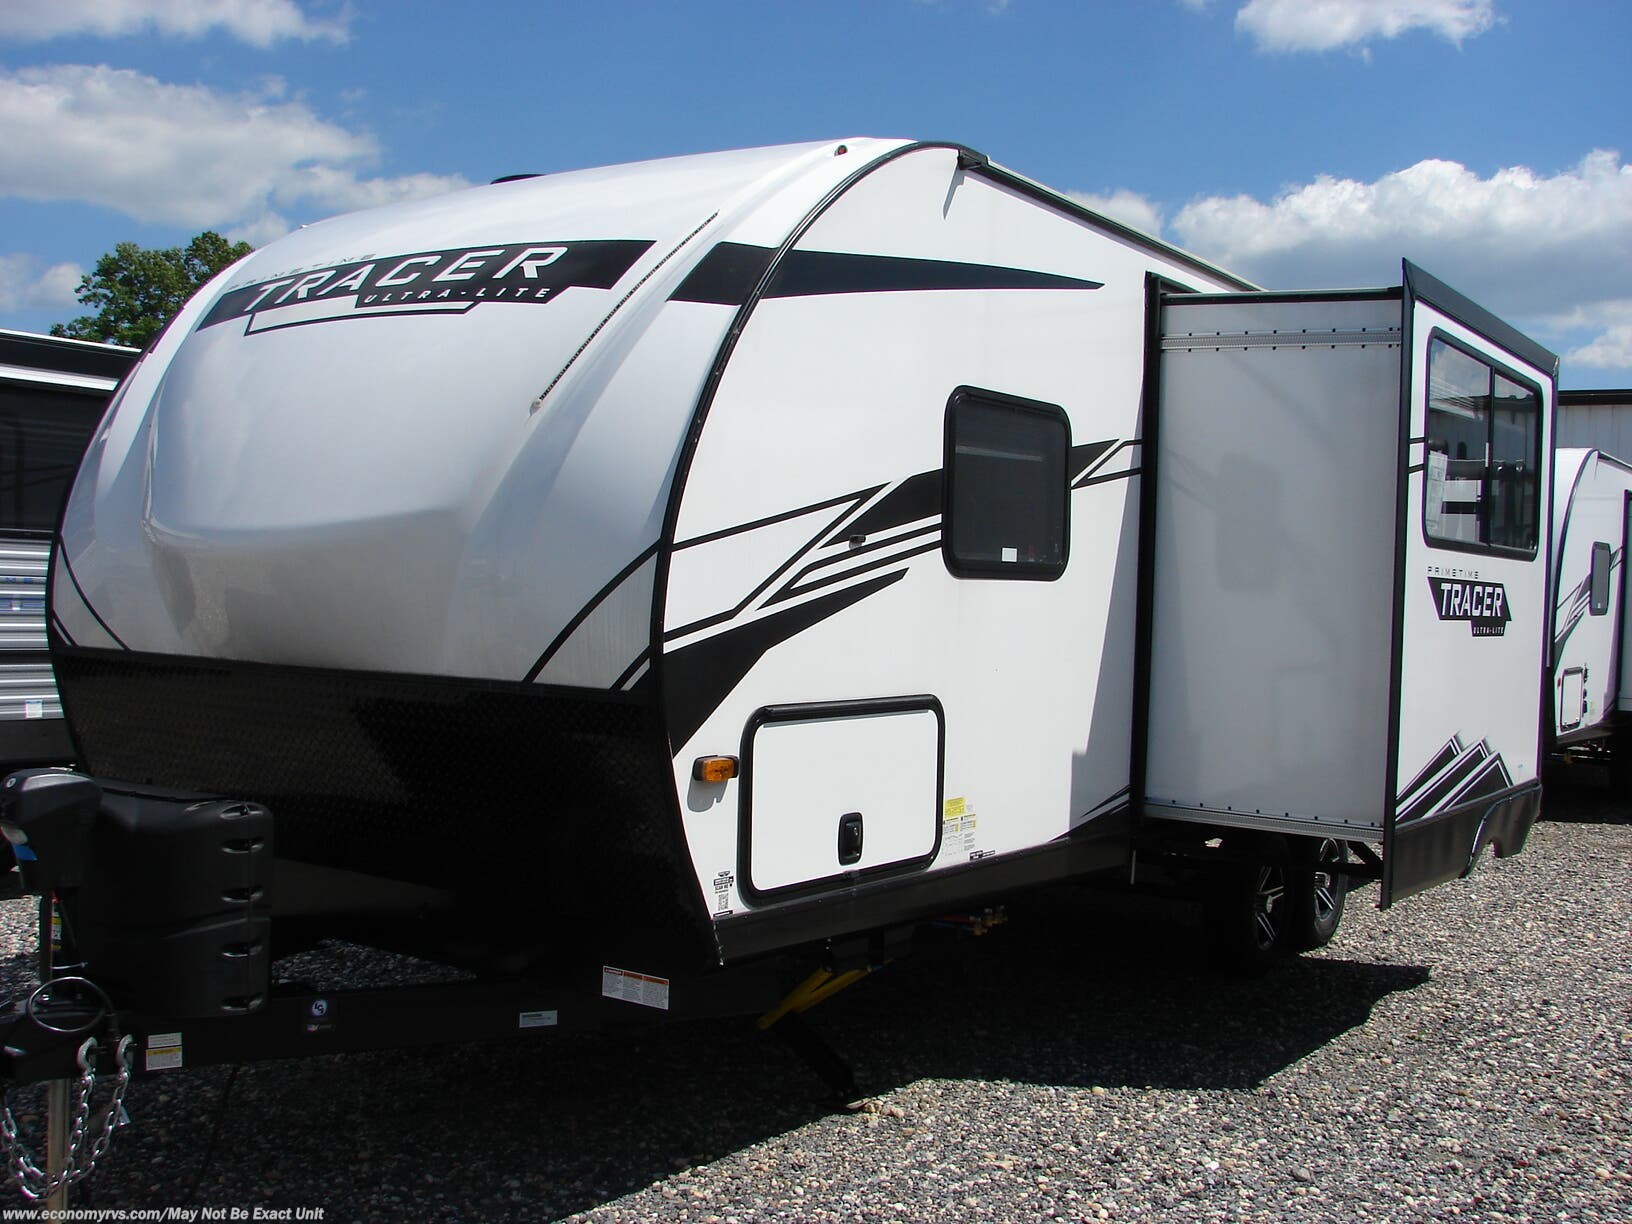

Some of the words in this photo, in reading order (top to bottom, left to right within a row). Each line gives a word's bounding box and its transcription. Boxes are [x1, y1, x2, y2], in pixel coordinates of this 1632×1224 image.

[244, 247, 568, 313] TRACER
[364, 287, 551, 304] ULTRA-LITE
[1427, 566, 1479, 579] PRIMETIME
[1441, 582, 1503, 617] TRACER
[1473, 626, 1504, 635] ULTRA-LITE
